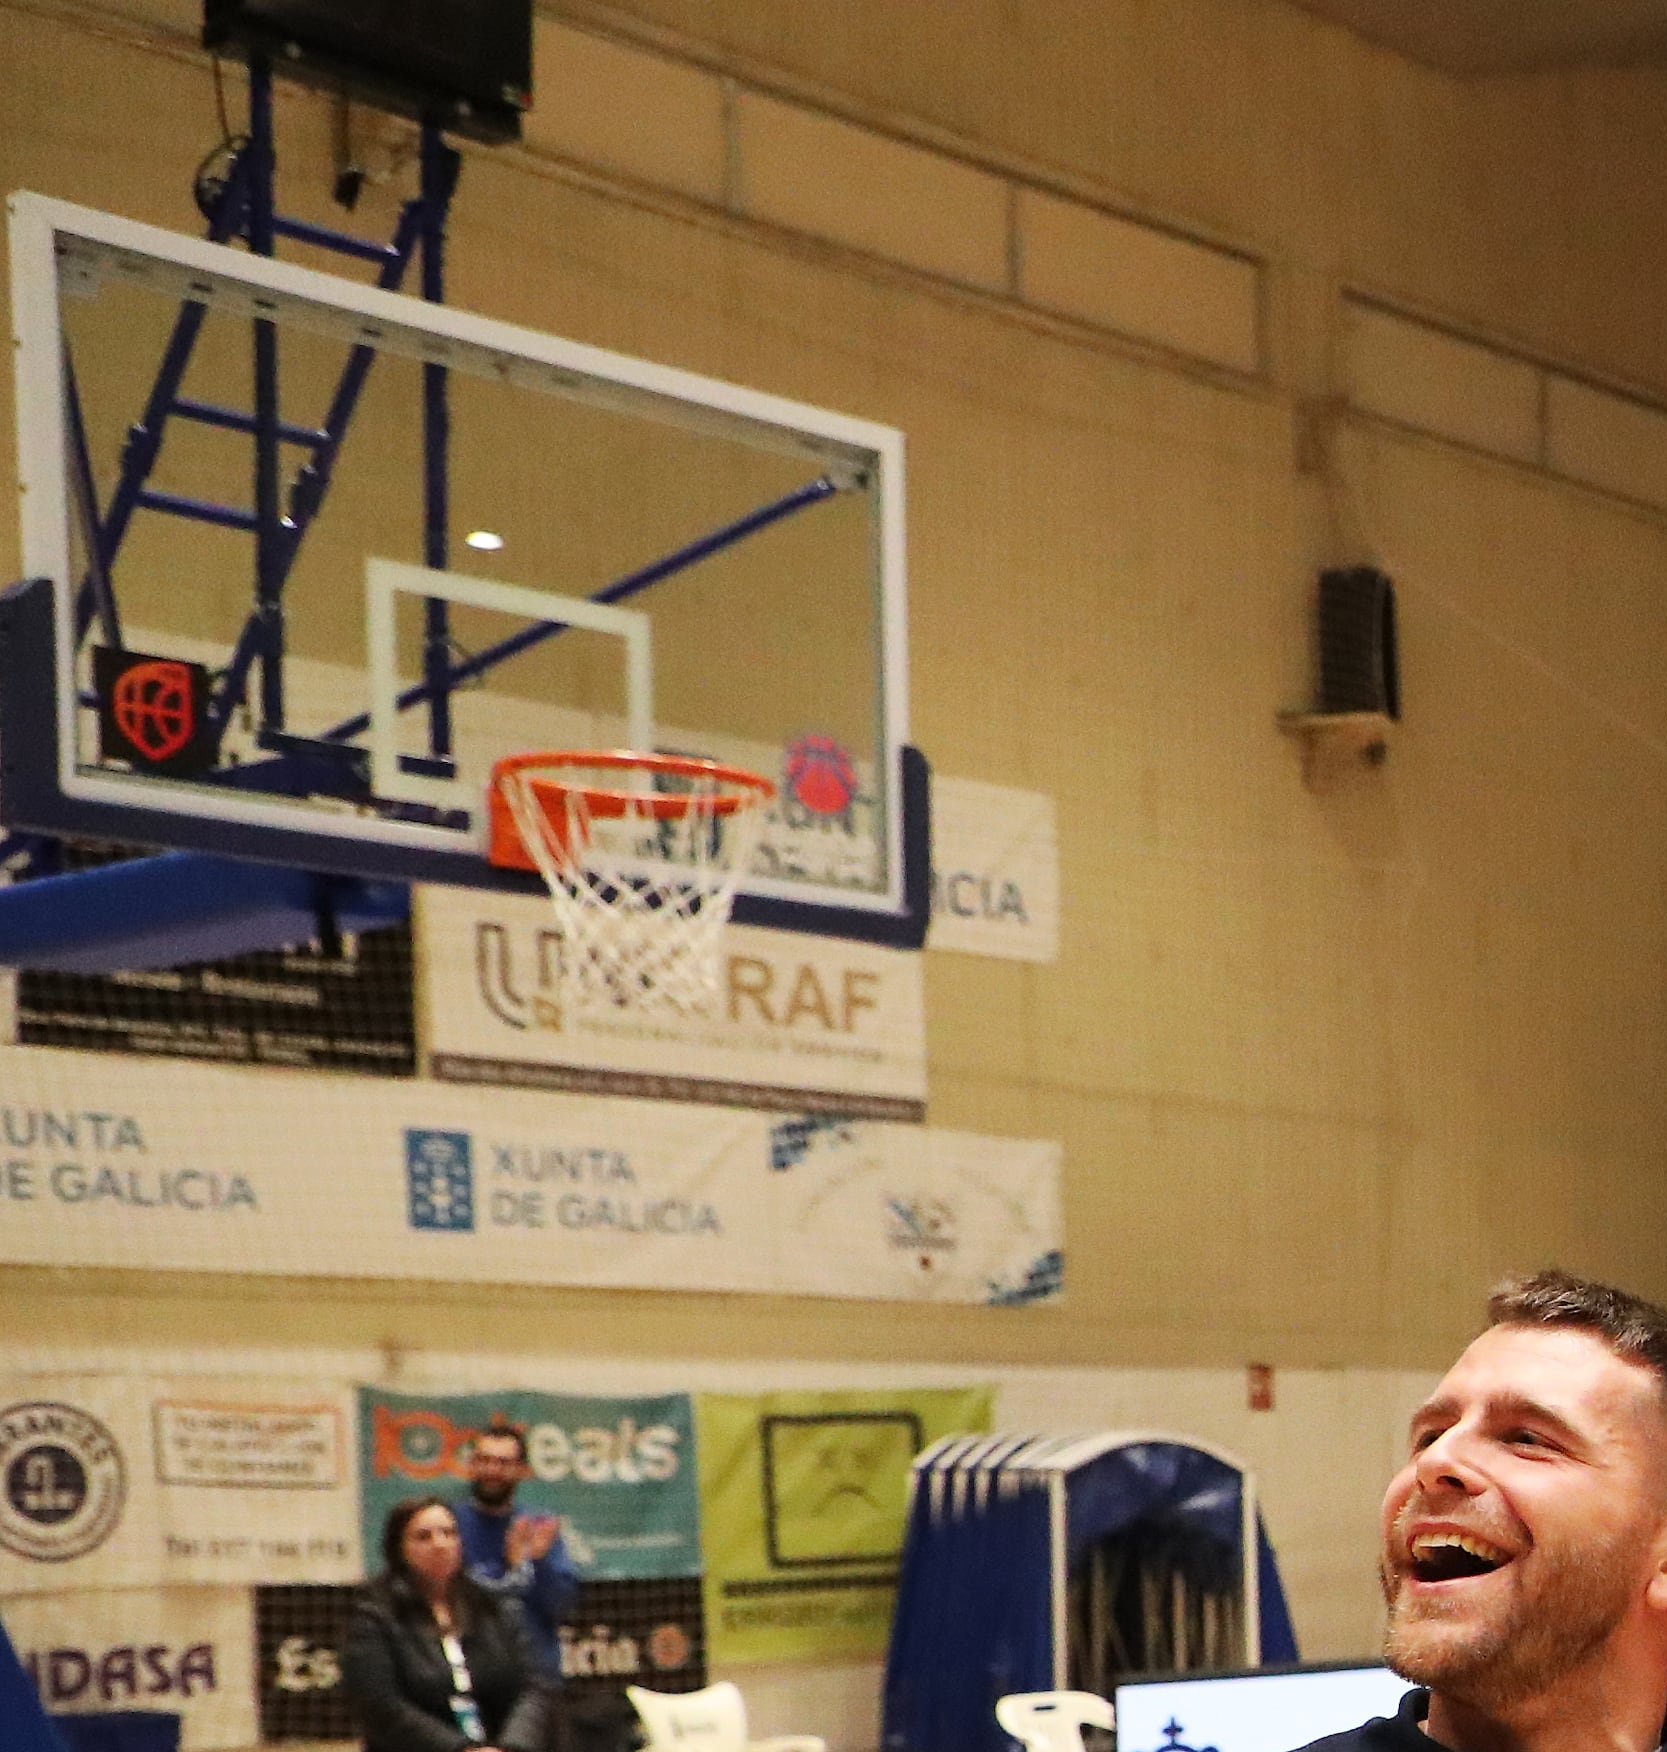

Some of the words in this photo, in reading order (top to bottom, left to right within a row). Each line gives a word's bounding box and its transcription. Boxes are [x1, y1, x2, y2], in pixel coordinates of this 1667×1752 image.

[0, 1108, 149, 1155] UNTA
[49, 1162, 260, 1213] GALICIA
[490, 1142, 636, 1184] XUNTA
[490, 1187, 546, 1230] DE
[555, 1191, 723, 1239] GALICIA
